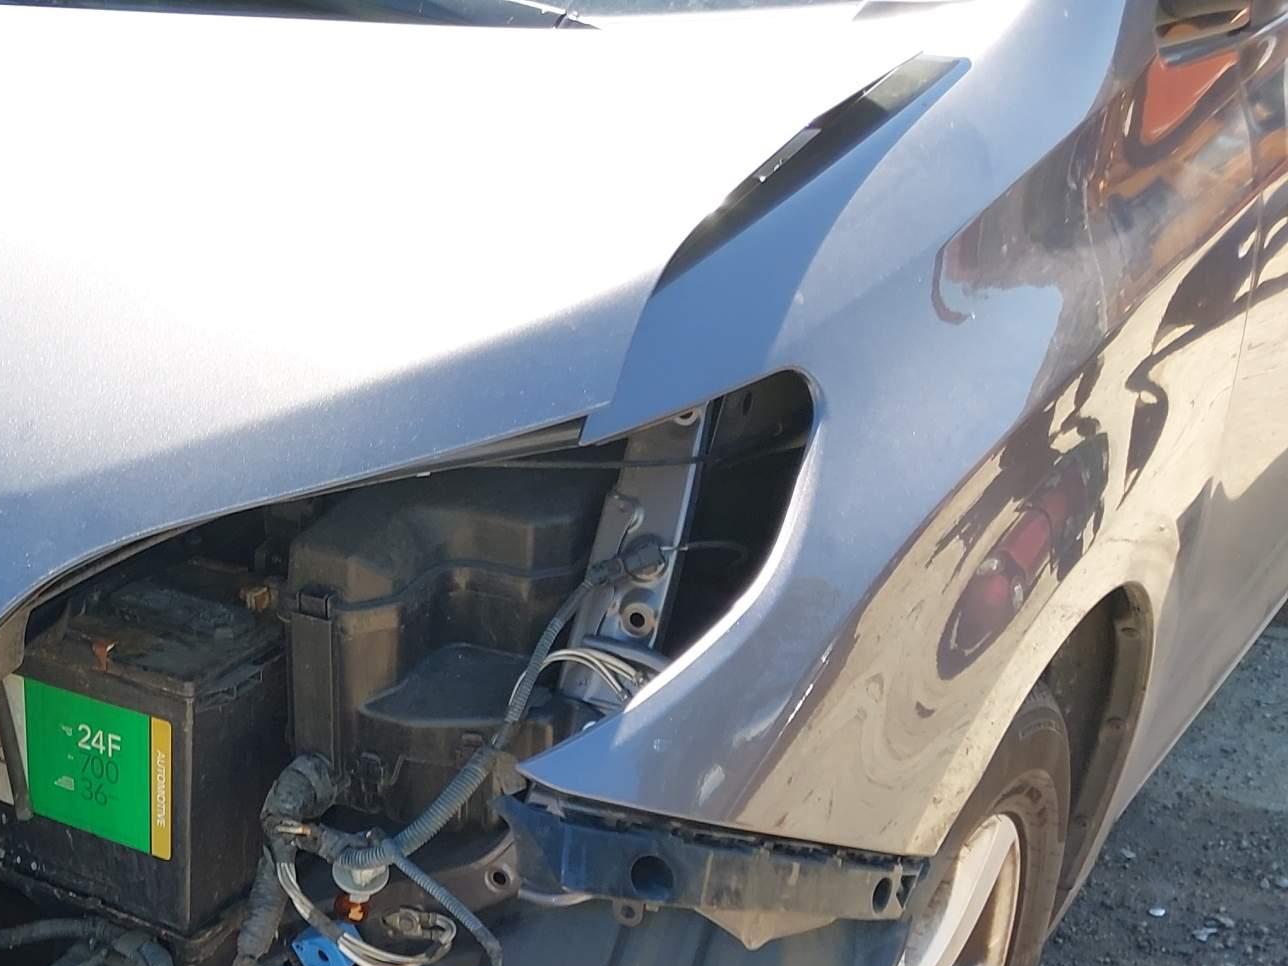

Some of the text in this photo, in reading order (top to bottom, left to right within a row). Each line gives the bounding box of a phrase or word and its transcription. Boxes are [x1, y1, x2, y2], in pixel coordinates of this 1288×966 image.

[78, 723, 121, 758] 24F
[79, 751, 119, 784] 700
[81, 777, 108, 806] 36
[156, 750, 166, 829] AUTOMOTIVE
